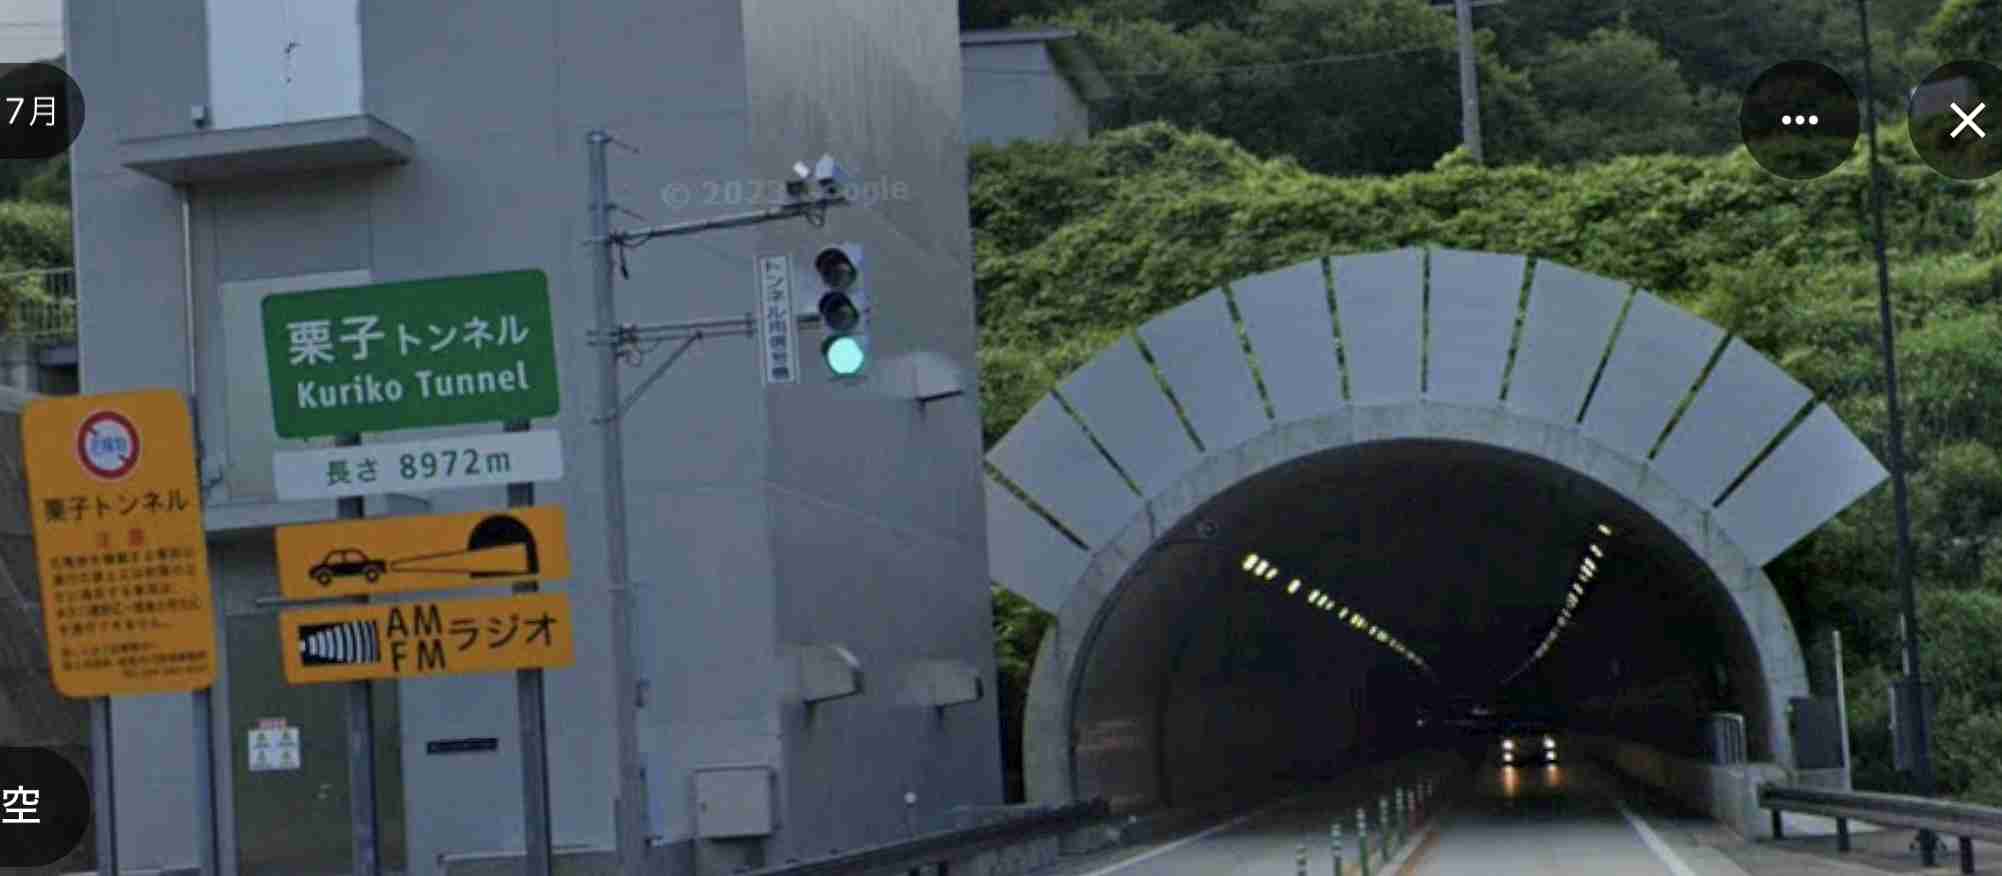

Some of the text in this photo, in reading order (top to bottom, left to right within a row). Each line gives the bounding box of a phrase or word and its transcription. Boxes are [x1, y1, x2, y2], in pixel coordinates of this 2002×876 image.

[286, 313, 529, 366] 栗子トンネル
[297, 360, 529, 409] Kuriko Tunnel
[326, 448, 511, 487] 長さ 8972m
[386, 603, 443, 637] AM
[449, 611, 558, 651] ラジオ
[391, 638, 446, 672] FM
